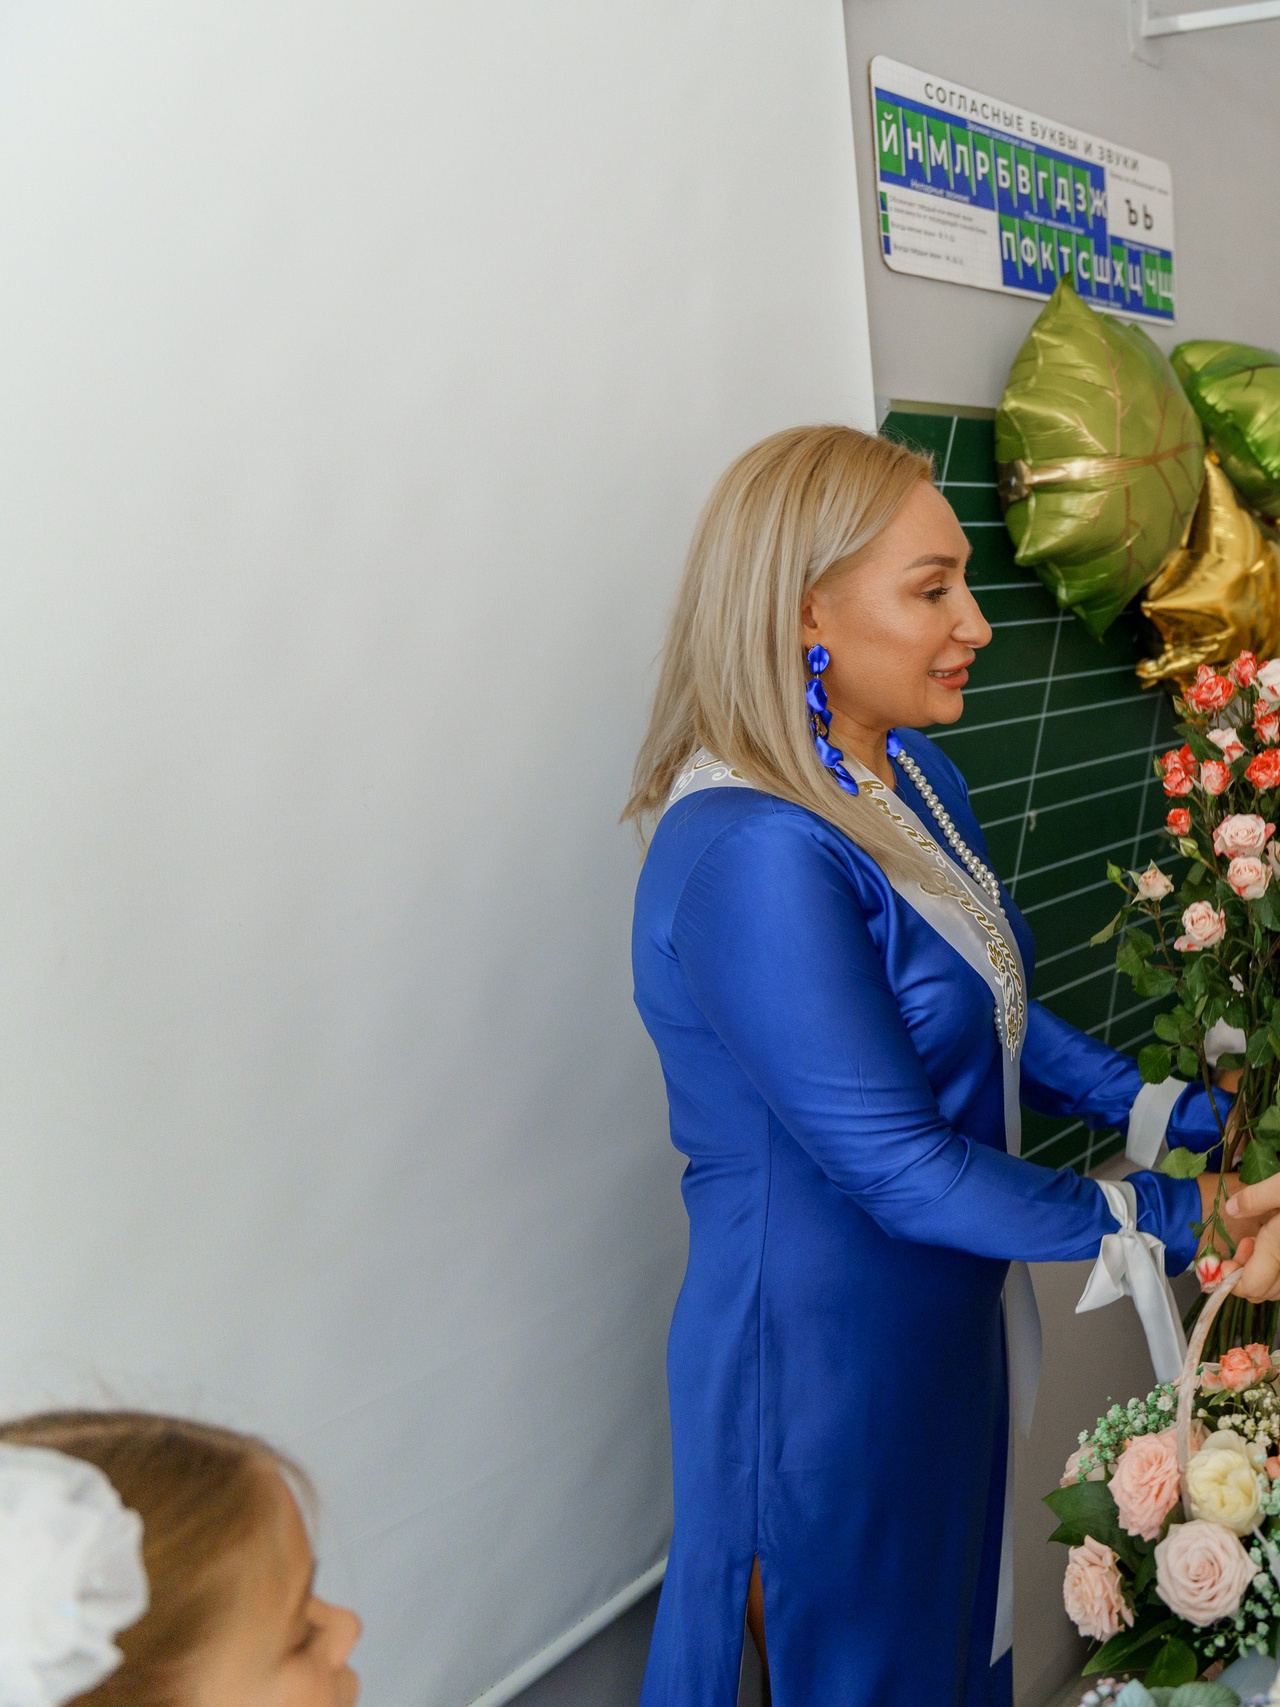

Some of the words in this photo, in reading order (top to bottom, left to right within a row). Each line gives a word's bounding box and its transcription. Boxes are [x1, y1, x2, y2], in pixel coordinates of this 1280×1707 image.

[924, 83, 1024, 132] СОГЛАСНЫЕ
[1030, 121, 1079, 151] БУКВЫ
[1083, 141, 1094, 157] И
[1098, 145, 1139, 170] ЗВУКИ
